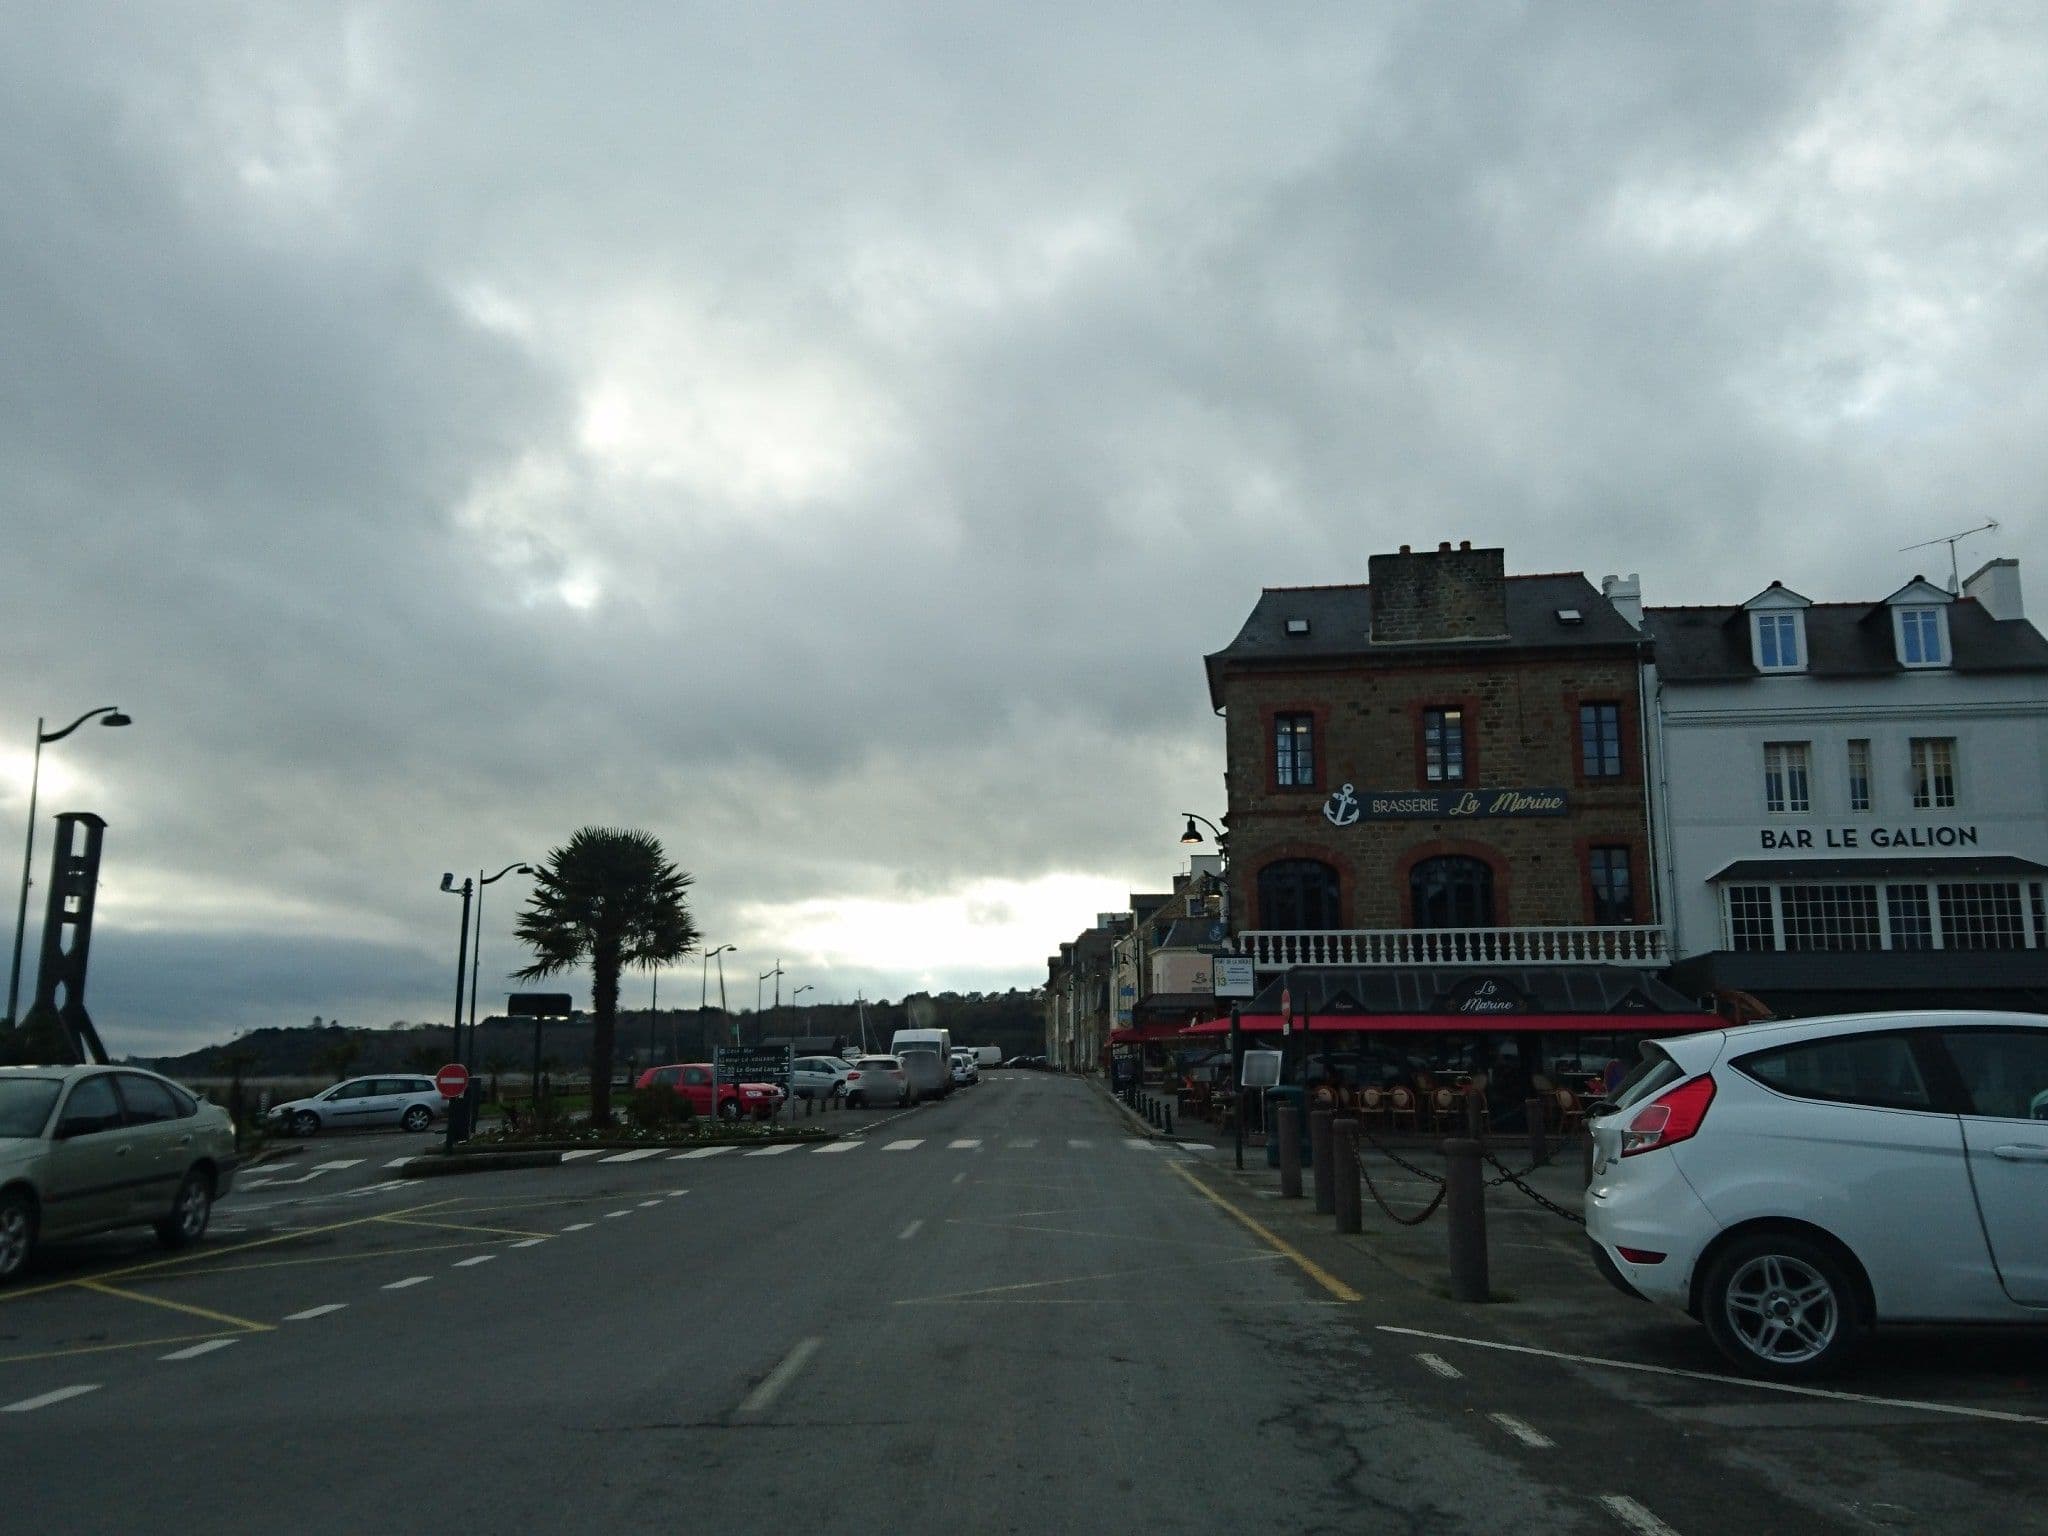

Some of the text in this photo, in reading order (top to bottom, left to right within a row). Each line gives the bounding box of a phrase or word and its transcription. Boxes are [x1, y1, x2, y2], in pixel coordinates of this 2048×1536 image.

[1372, 792, 1563, 815] BRASSERIE La Marine
[1761, 826, 1978, 849] BAR LE GALION
[1474, 980, 1498, 995] La
[1460, 998, 1514, 1012] Marine
